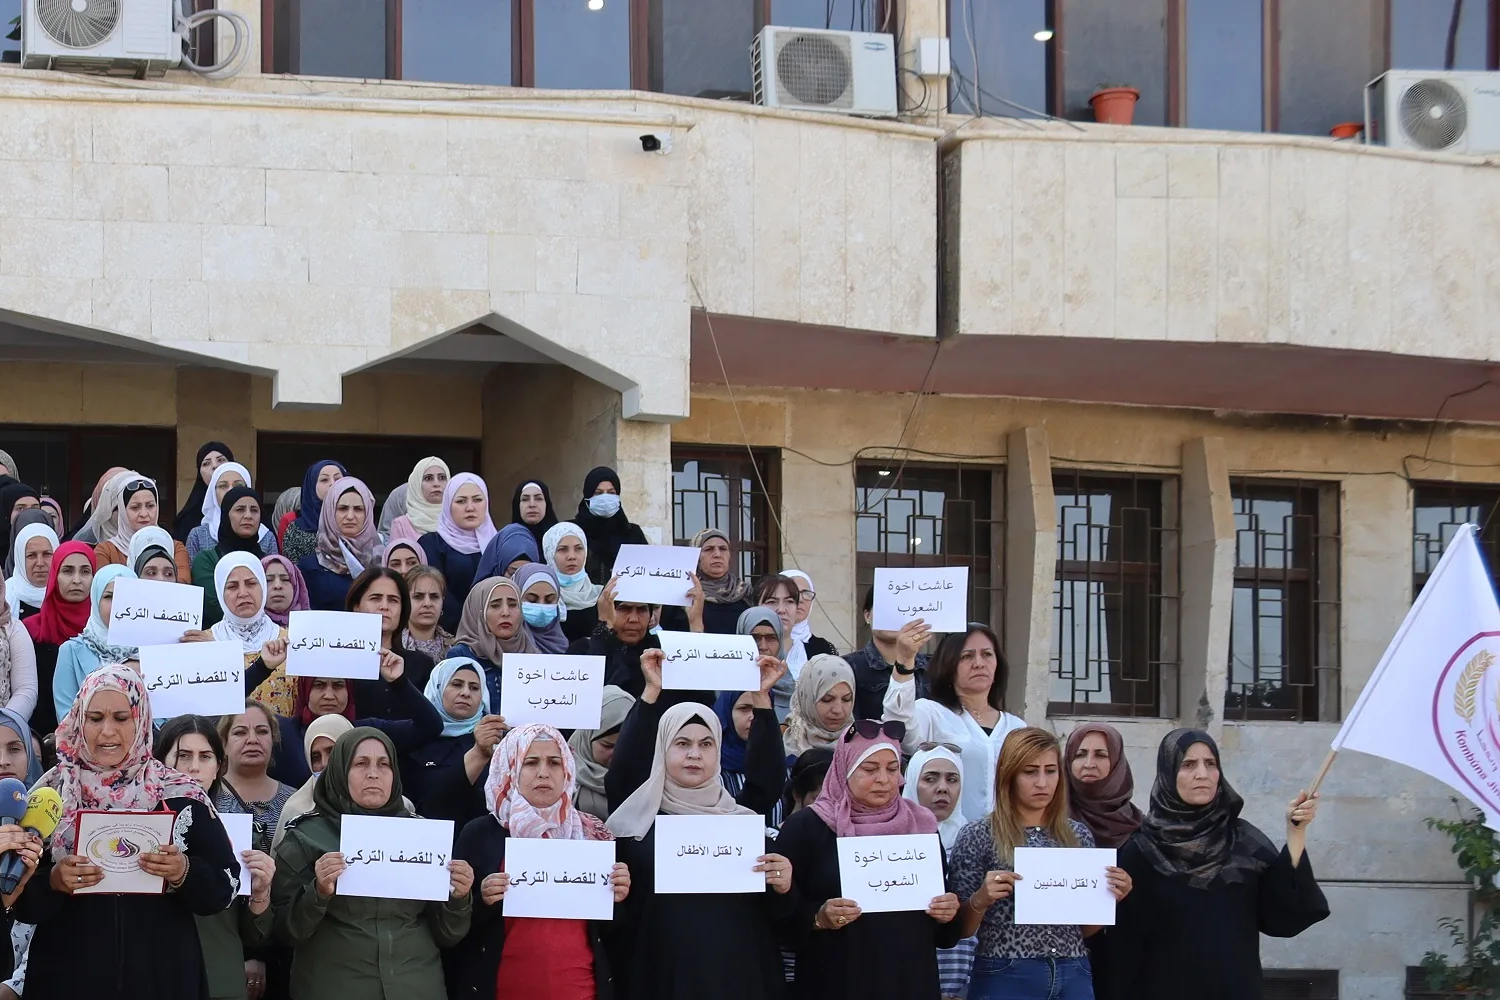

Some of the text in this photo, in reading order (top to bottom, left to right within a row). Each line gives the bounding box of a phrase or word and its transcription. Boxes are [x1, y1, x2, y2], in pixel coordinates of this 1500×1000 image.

[616, 566, 645, 578] التركي
[649, 568, 681, 578] للقصف
[918, 580, 953, 590] عاشت
[898, 601, 942, 616] الشعوب
[115, 607, 199, 625] لا للقصف التركي
[292, 637, 377, 652] لا للقصف التركي
[666, 649, 754, 661] لا للقصف التركي
[551, 669, 589, 681] عاشت
[147, 671, 239, 692] لا للقصف التركي
[528, 693, 577, 709] الشعوب
[346, 849, 447, 866] لا للقصف التركي
[713, 846, 731, 857] لقتل
[736, 847, 742, 856] لا
[888, 849, 926, 861] عاشت
[510, 871, 610, 886] لا للقصف التركي
[868, 874, 918, 892] الشعوب
[1034, 878, 1097, 889] لا لقتل المدنيين
